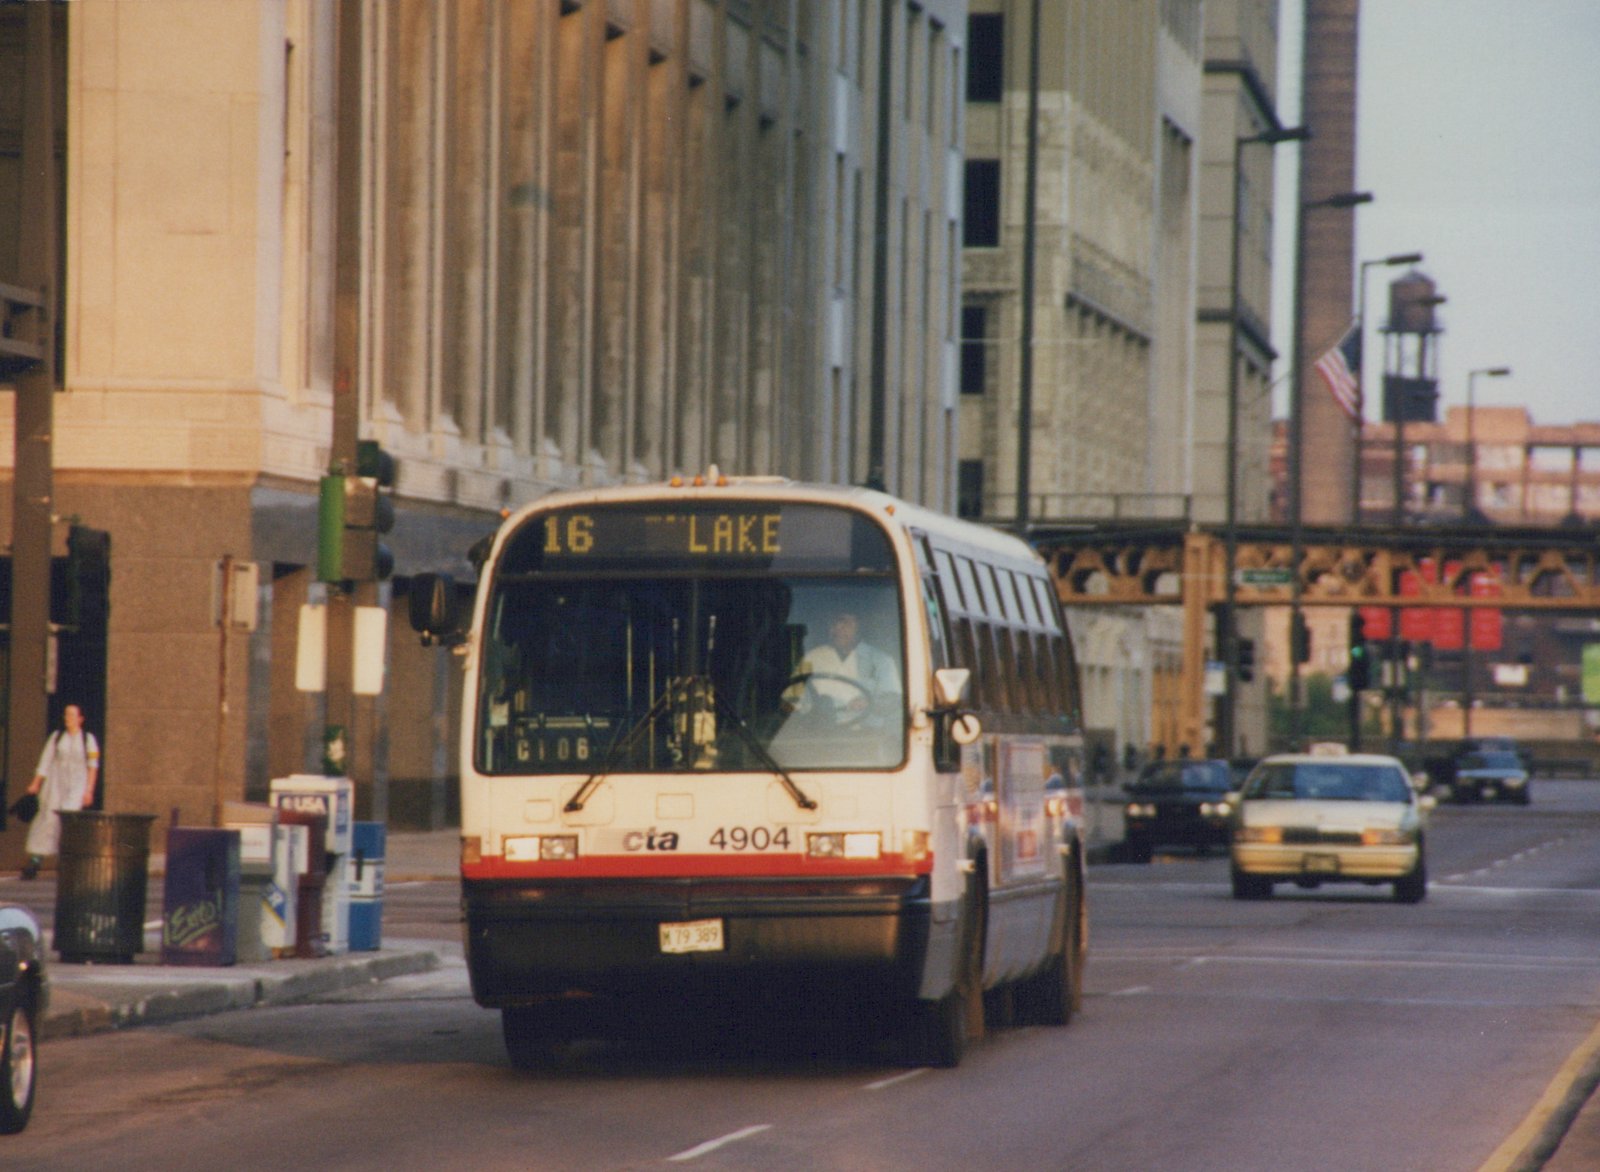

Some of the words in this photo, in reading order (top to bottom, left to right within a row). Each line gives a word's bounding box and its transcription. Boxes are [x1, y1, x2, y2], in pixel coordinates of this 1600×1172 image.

[543, 515, 594, 553] 16
[688, 514, 783, 553] LAKE
[294, 796, 326, 813] USA
[623, 827, 680, 851] cta
[709, 827, 791, 851] 4904
